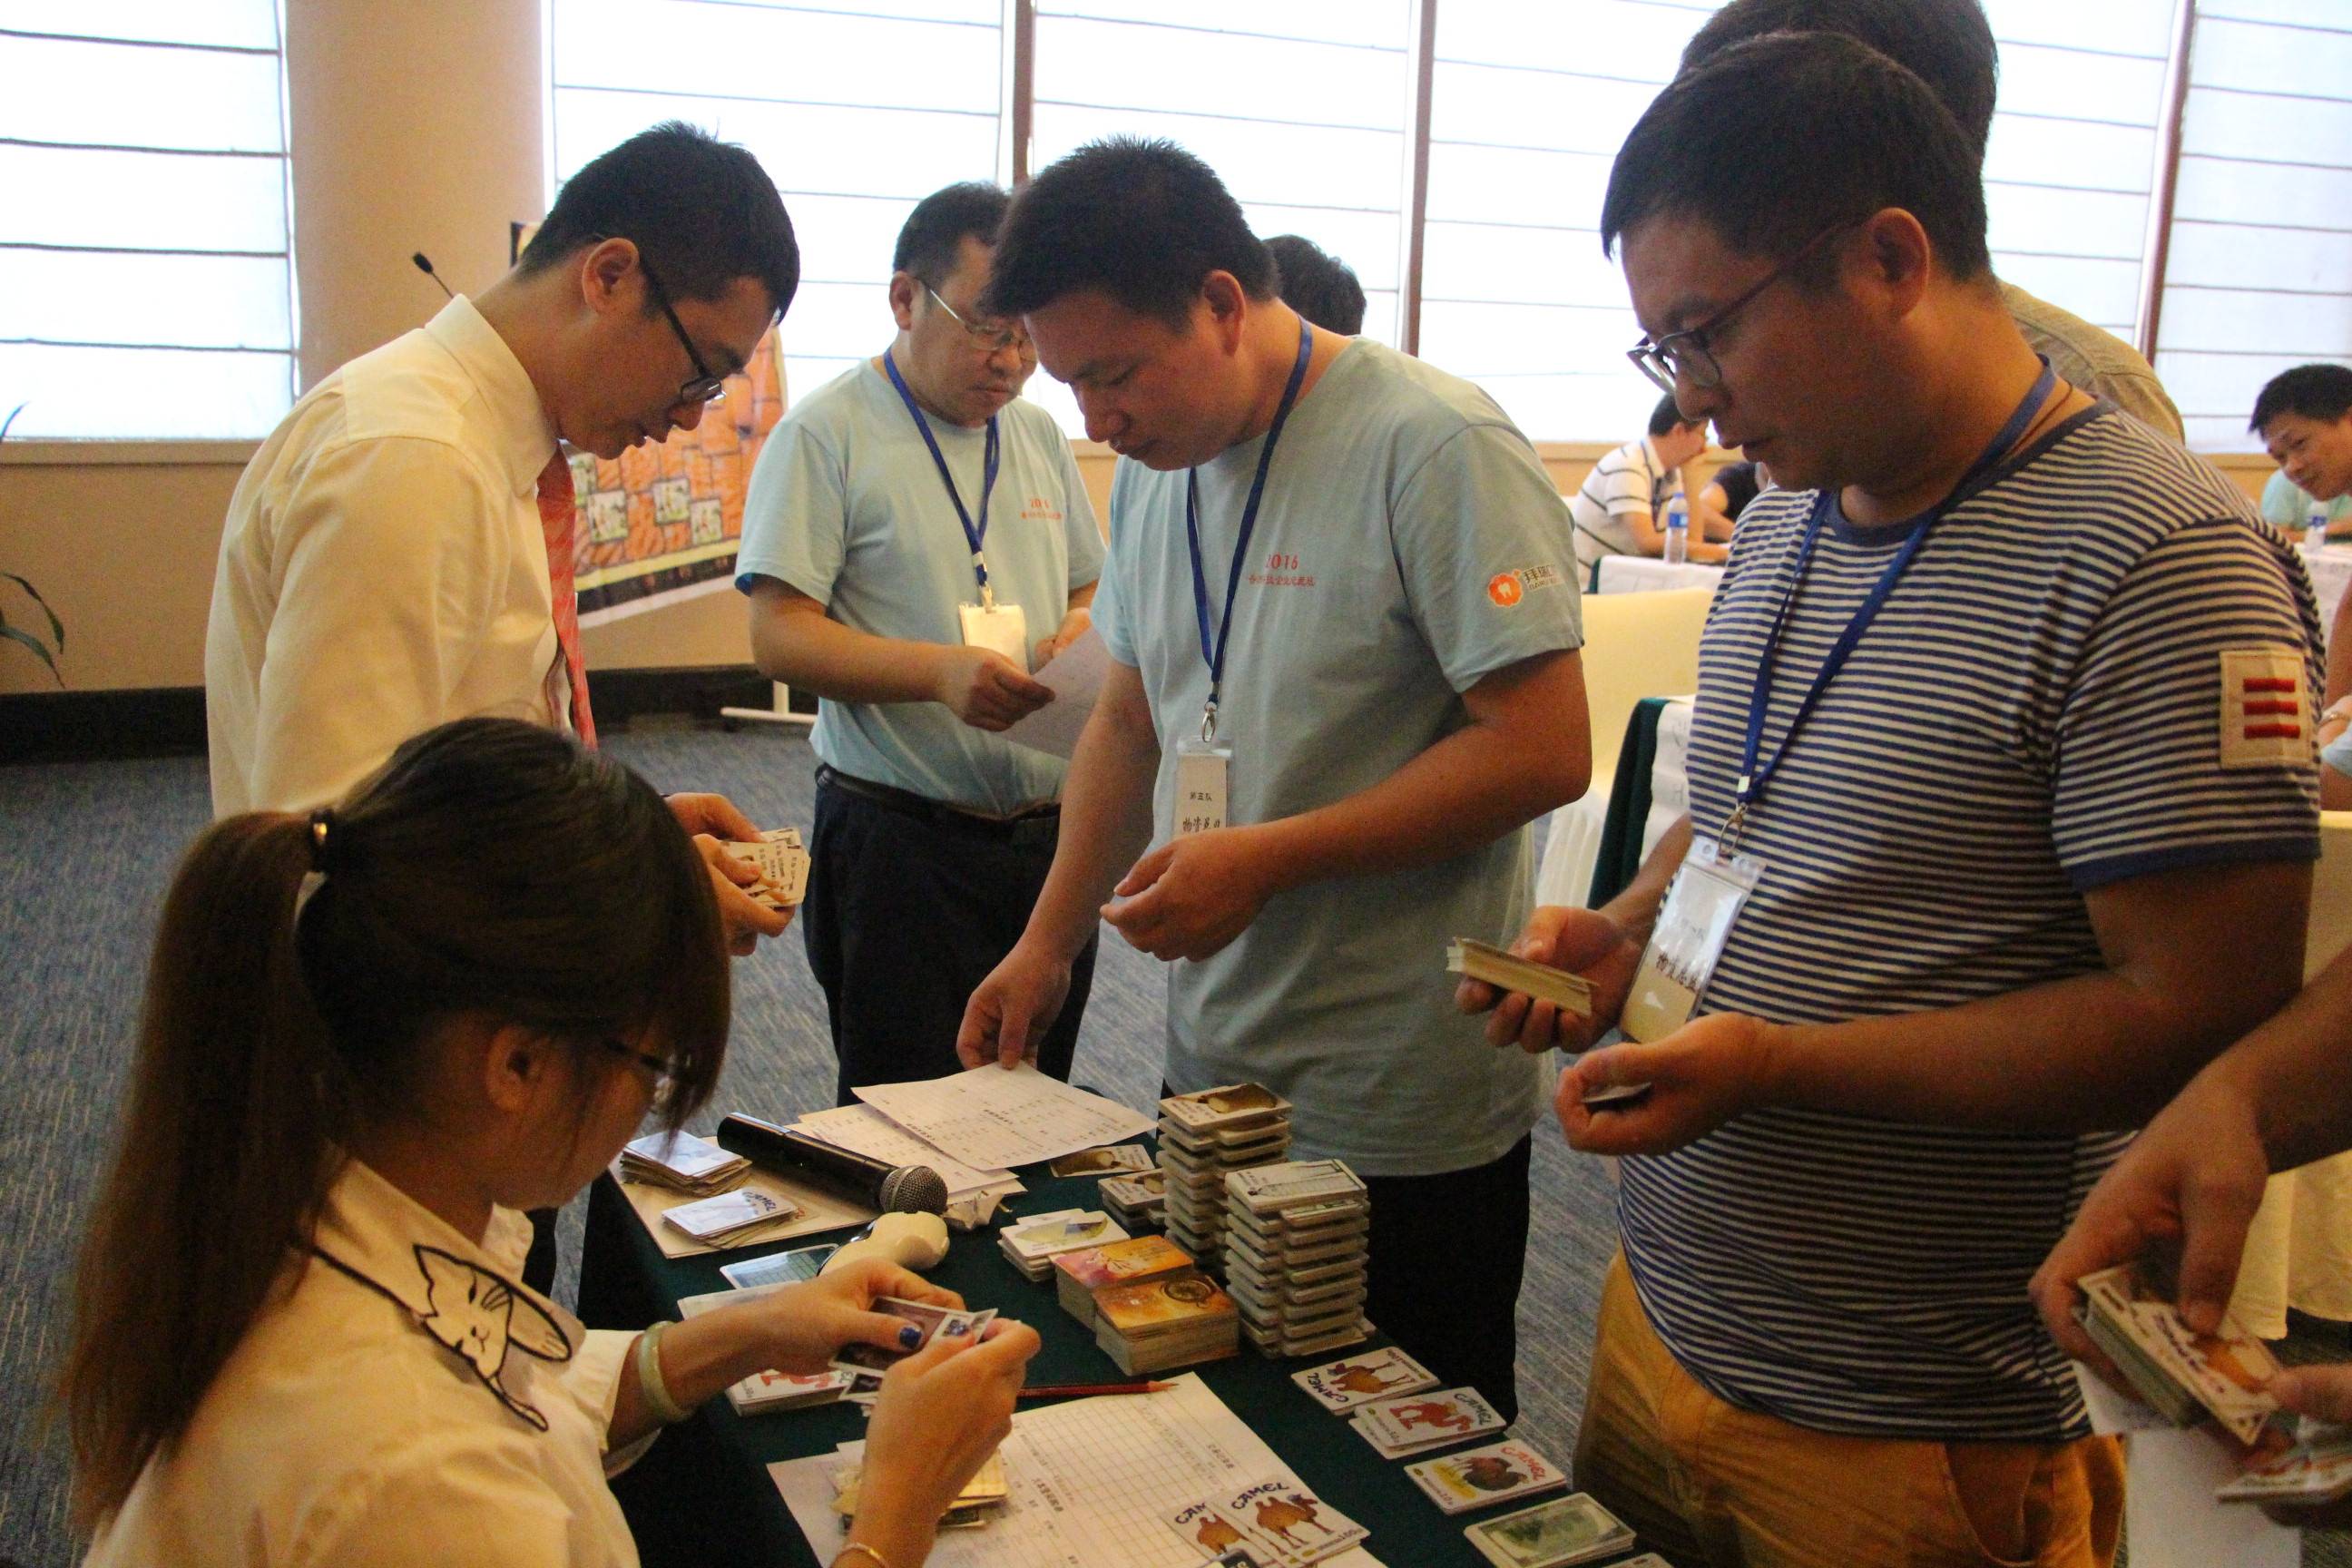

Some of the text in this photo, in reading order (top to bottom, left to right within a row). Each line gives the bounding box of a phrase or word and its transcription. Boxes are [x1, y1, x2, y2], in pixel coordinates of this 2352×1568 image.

[1308, 1373, 1349, 1403] CAMEL
[1455, 1393, 1491, 1426] CAMEL
[1501, 1446, 1545, 1481] CAMEL
[1231, 1483, 1289, 1509] CAMEL
[1175, 1503, 1205, 1524] CAM
